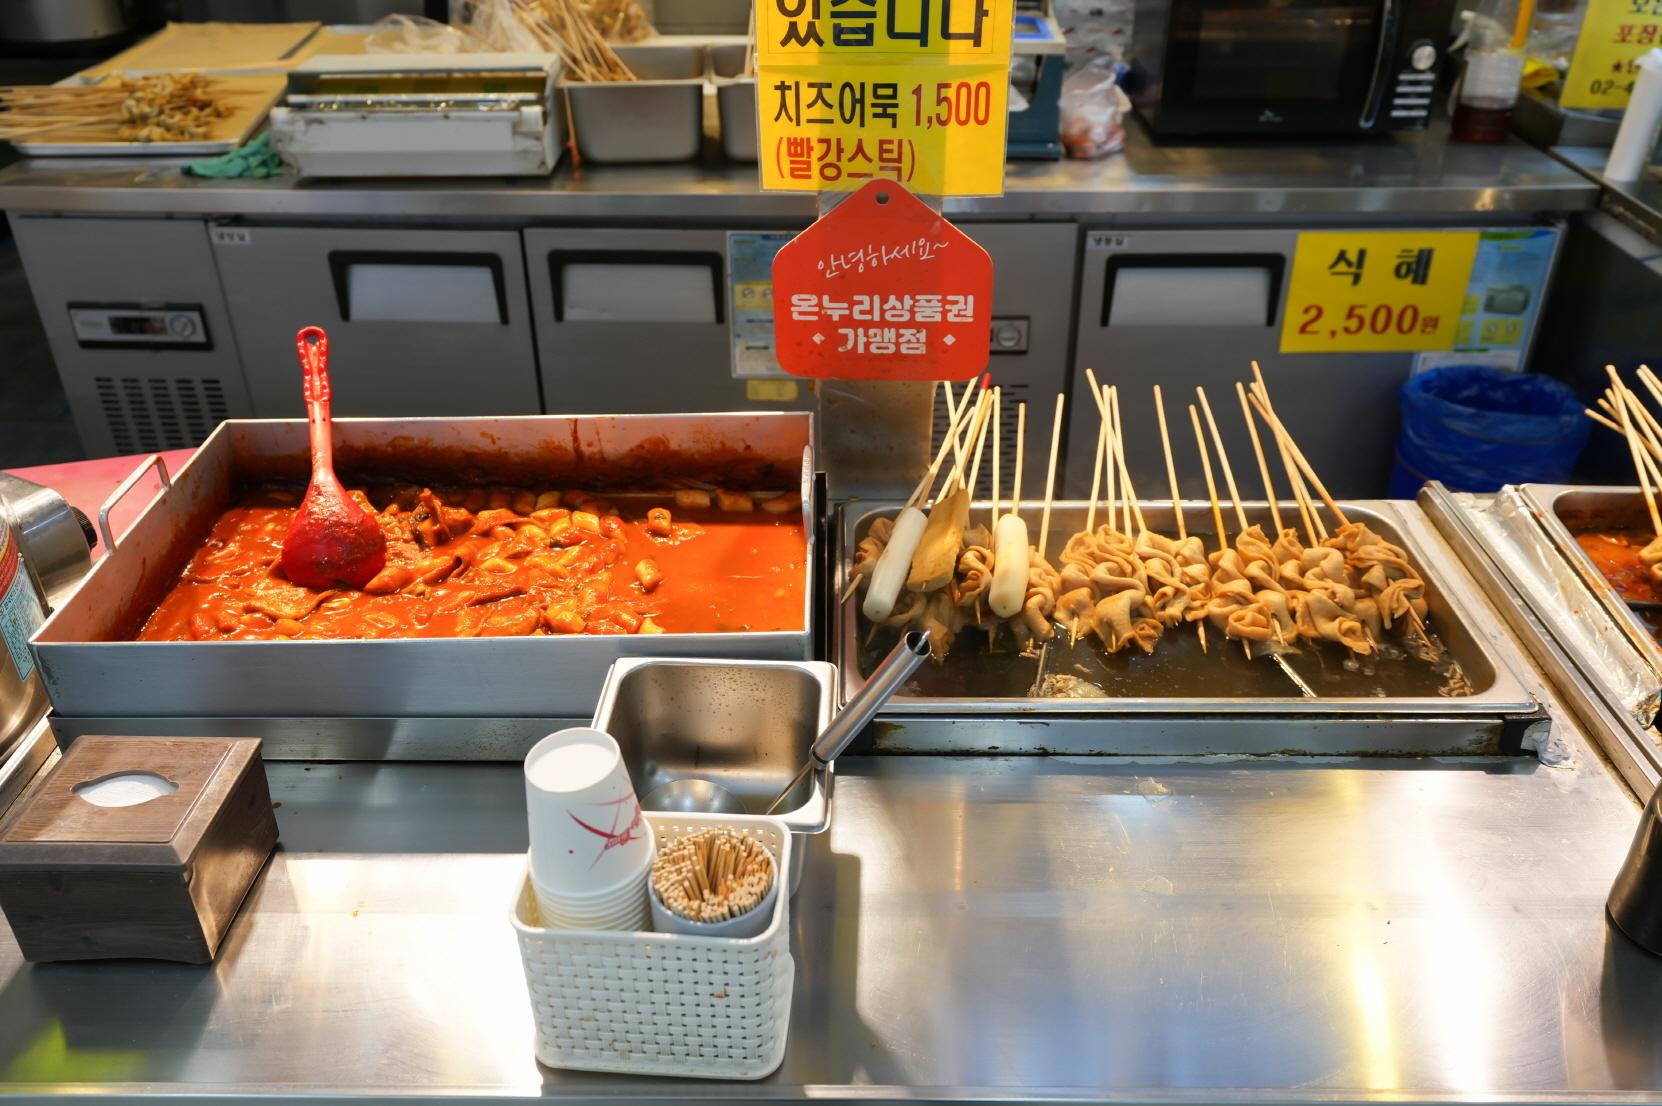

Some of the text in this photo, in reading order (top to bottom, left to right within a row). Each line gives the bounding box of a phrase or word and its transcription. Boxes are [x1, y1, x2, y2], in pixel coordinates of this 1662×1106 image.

[777, 0, 989, 48] 있습니다
[773, 80, 991, 130] 치즈어묵 1,500
[776, 136, 916, 183] (빨강스틱)
[790, 293, 975, 323] 온누리상품권
[837, 326, 927, 355] 가맹점
